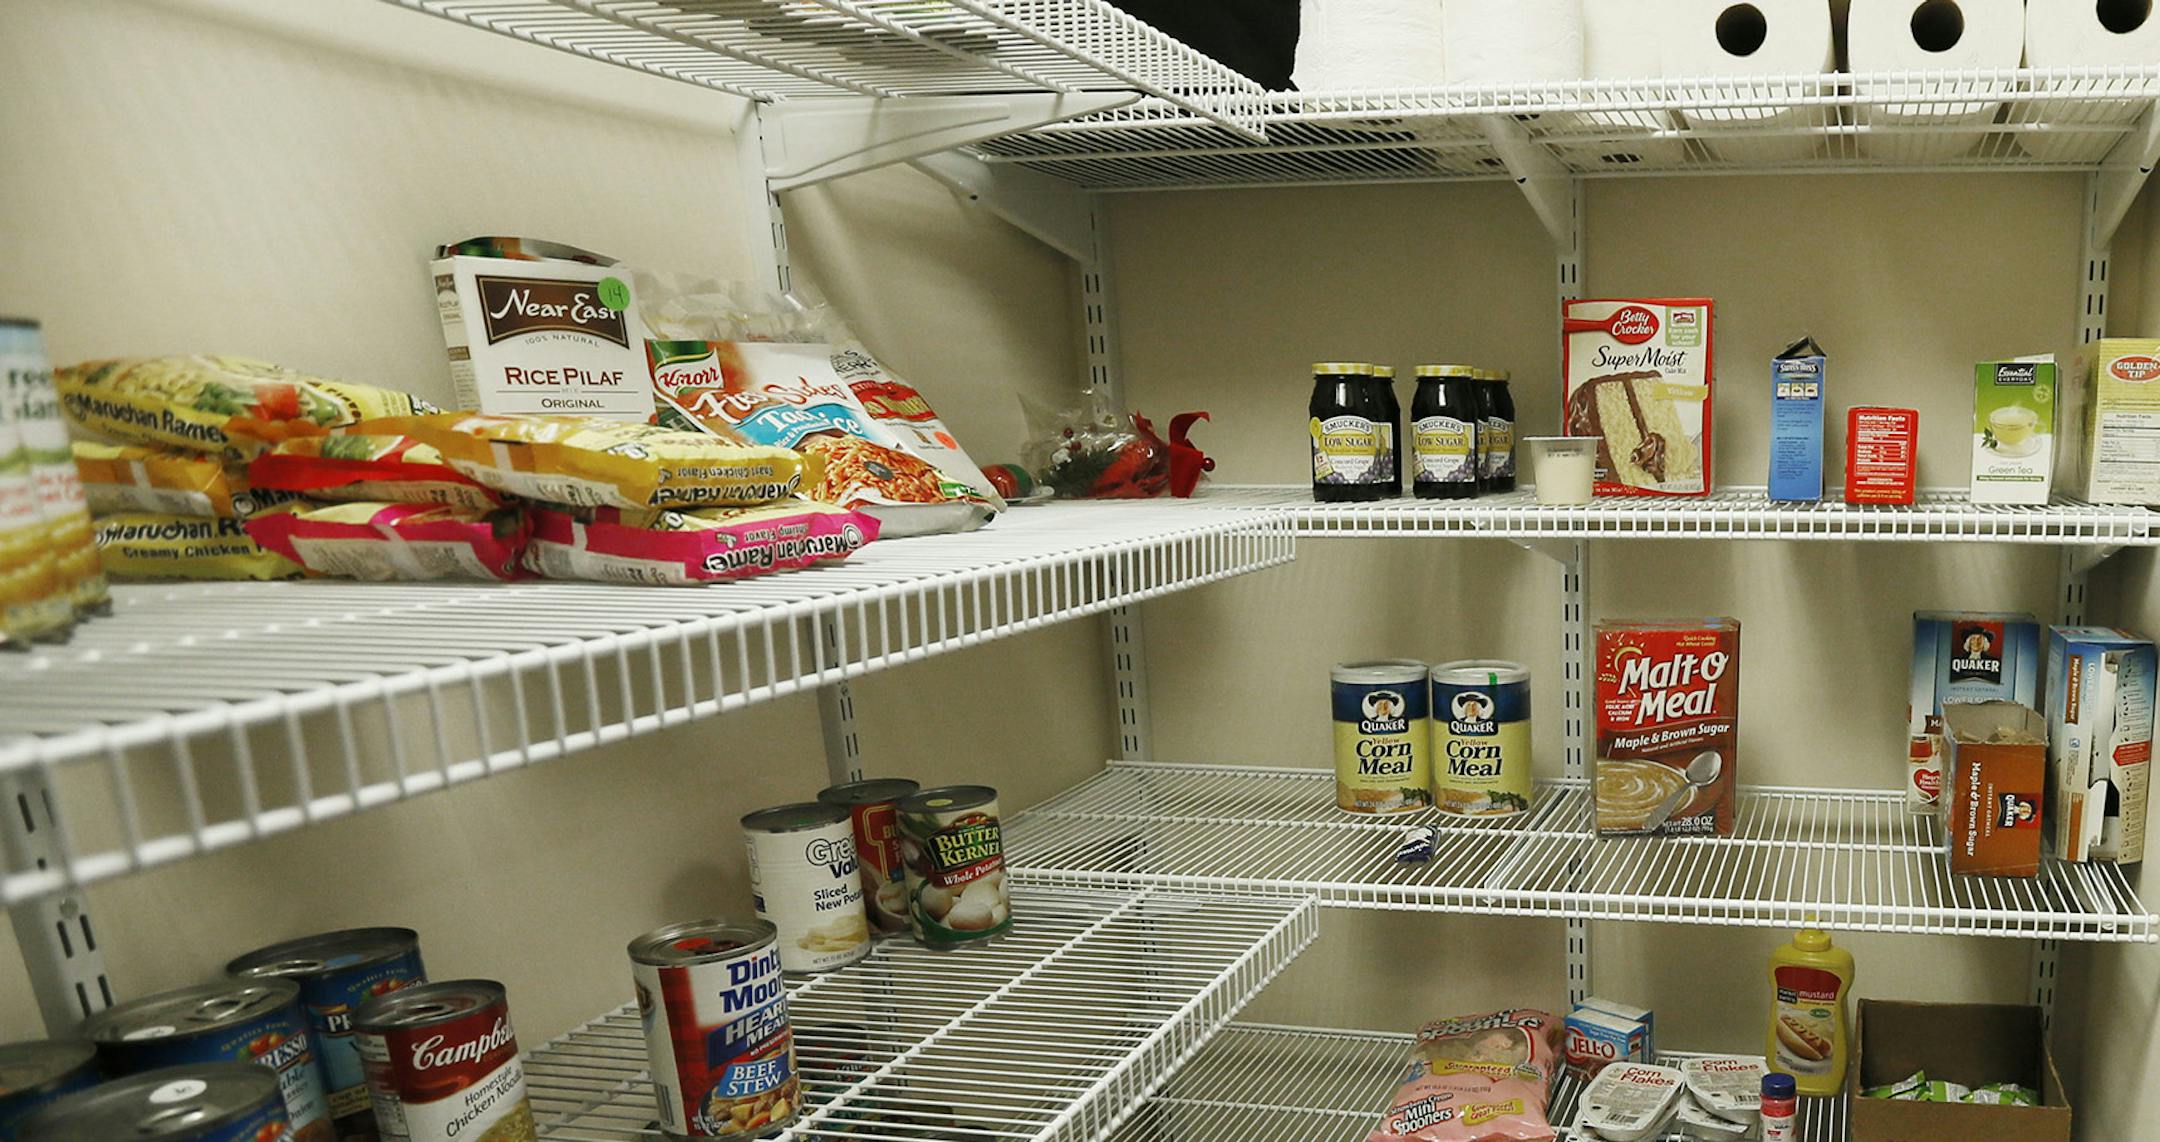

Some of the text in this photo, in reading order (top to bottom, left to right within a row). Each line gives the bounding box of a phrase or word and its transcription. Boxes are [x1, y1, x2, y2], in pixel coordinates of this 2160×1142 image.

[490, 288, 569, 319] Near
[608, 286, 625, 305] 14
[1620, 309, 1650, 327] Betty
[1611, 321, 1655, 336] Crocker
[552, 333, 600, 348] NATURAL
[2116, 361, 2159, 371] GOLDEN
[2128, 370, 2146, 379] TIP
[504, 366, 624, 386] RICE PILAF
[658, 366, 719, 388] Knorr
[75, 395, 158, 429] Maruchan
[541, 398, 605, 409] ORIGINAL
[677, 467, 708, 481] Flavor
[709, 466, 751, 480] Chicken
[1988, 465, 2033, 475] Green Tea
[744, 526, 776, 544] Flavor
[122, 544, 250, 559] Creamy Chicken
[1952, 658, 2000, 673] QUAKER
[1634, 682, 1716, 725] Meal
[1361, 719, 1406, 733] QUAKER
[1450, 720, 1494, 733] QUAKER
[1371, 737, 1400, 746] Yellow
[1459, 737, 1488, 747] Yellow
[1614, 723, 1730, 751] Maple & Brown Sugar
[1356, 739, 1412, 758] Corn
[1446, 741, 1501, 759] Corn
[1357, 755, 1413, 775] Meal
[1447, 757, 1502, 777] Meal
[1970, 762, 1981, 790] Maple
[1968, 801, 1979, 829] Brown
[2004, 794, 2016, 827] QUAKER
[936, 826, 1000, 851] BUTTER
[1966, 830, 1977, 857] Sugar
[944, 870, 974, 886] Whole
[813, 883, 848, 900] Sliced
[815, 899, 842, 911] New
[1799, 990, 1835, 1000] mustard
[731, 1060, 776, 1081] BEEF
[1626, 1066, 1662, 1078] Corn
[1702, 1064, 1760, 1072] Flakes
[726, 1070, 782, 1097] STEW
[1619, 1074, 1676, 1086] Flakes
[446, 1094, 496, 1138] Chicken
[1404, 1101, 1437, 1122] Mini
[1391, 1107, 1454, 1137] Spooners
